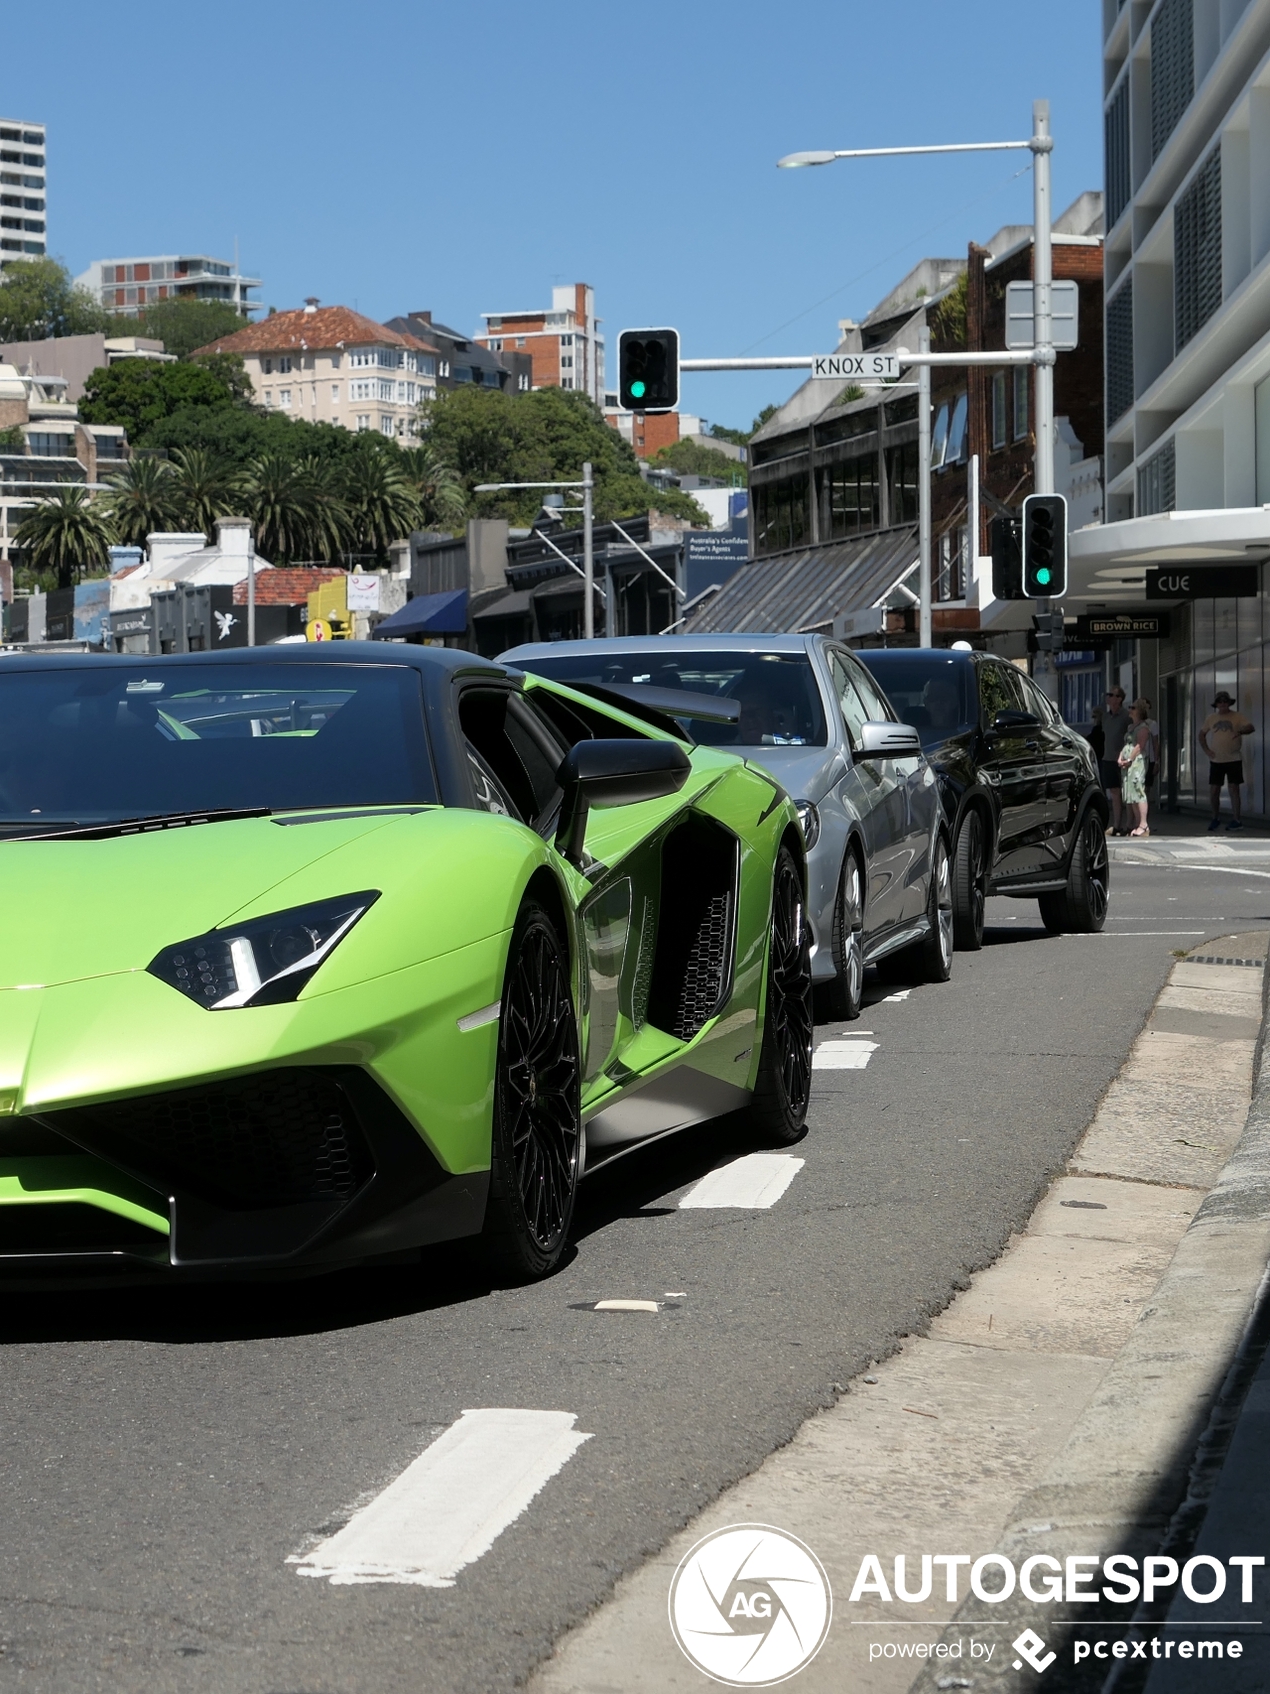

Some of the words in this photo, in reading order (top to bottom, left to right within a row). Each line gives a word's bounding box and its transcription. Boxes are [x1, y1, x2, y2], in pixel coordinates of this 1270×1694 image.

[815, 357, 864, 374] KNOX
[873, 357, 894, 373] ST
[712, 545, 731, 554] Agents
[1157, 575, 1190, 591] CUE
[1093, 622, 1130, 631] BROWN
[1133, 621, 1155, 630] RICE
